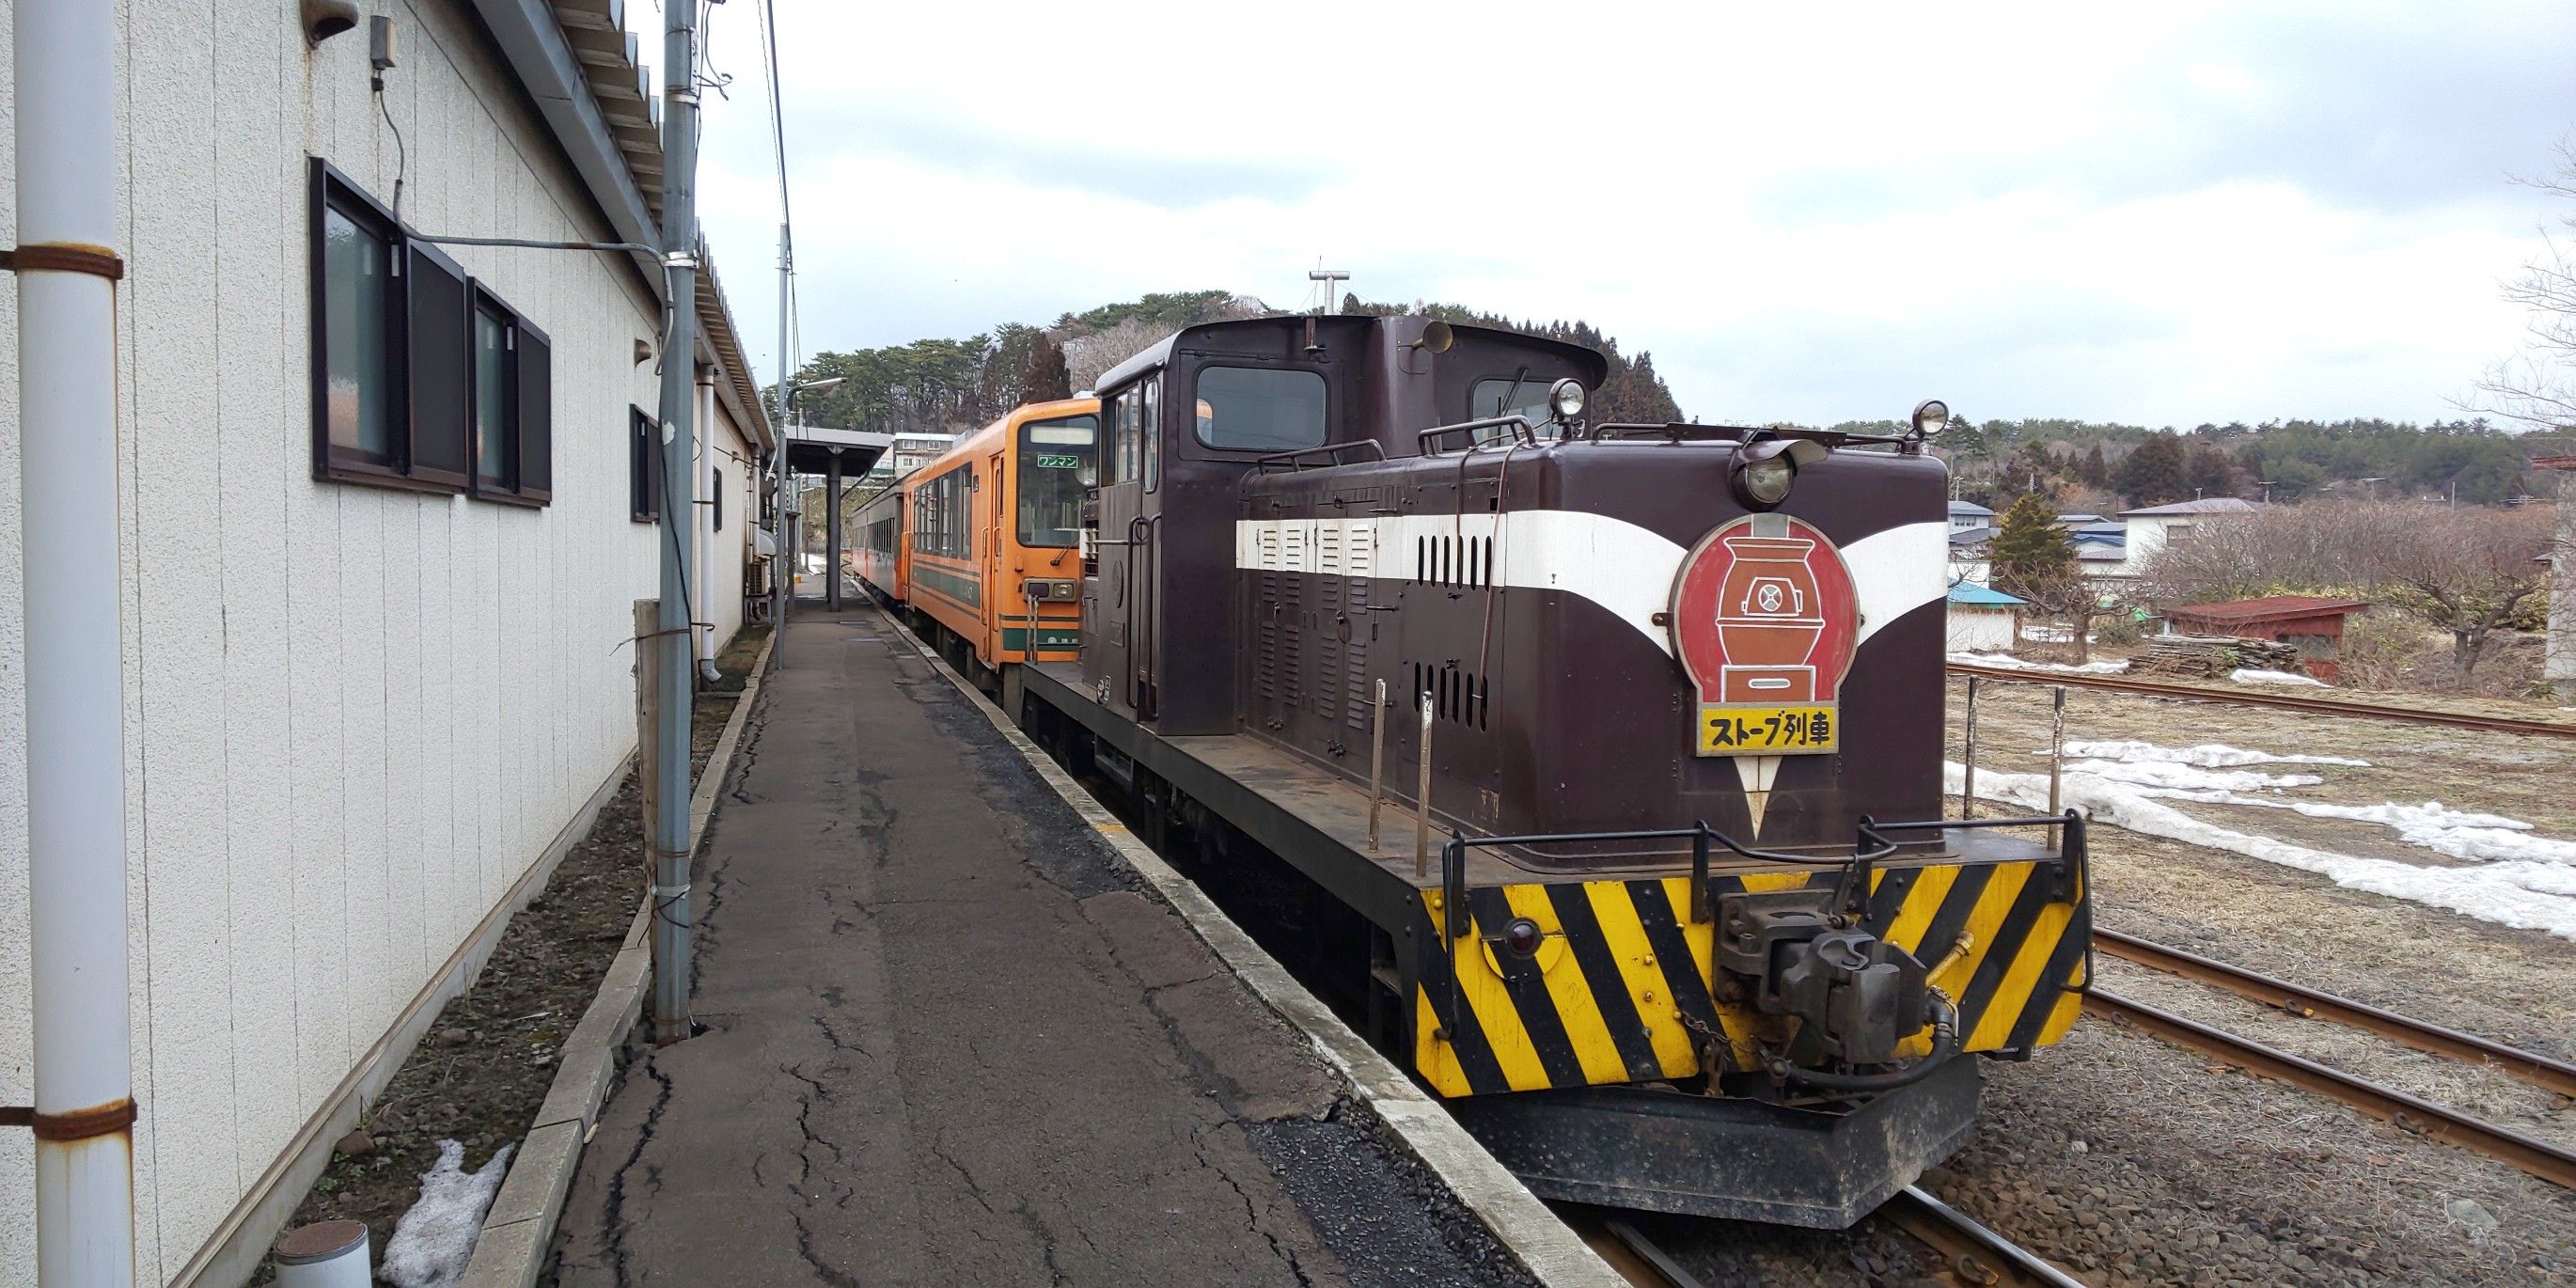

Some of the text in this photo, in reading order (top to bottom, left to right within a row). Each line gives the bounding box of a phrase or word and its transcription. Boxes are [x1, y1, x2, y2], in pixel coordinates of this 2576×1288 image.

[1039, 456, 1076, 466] ワンマン
[1709, 710, 1830, 746] ストーブ列車
